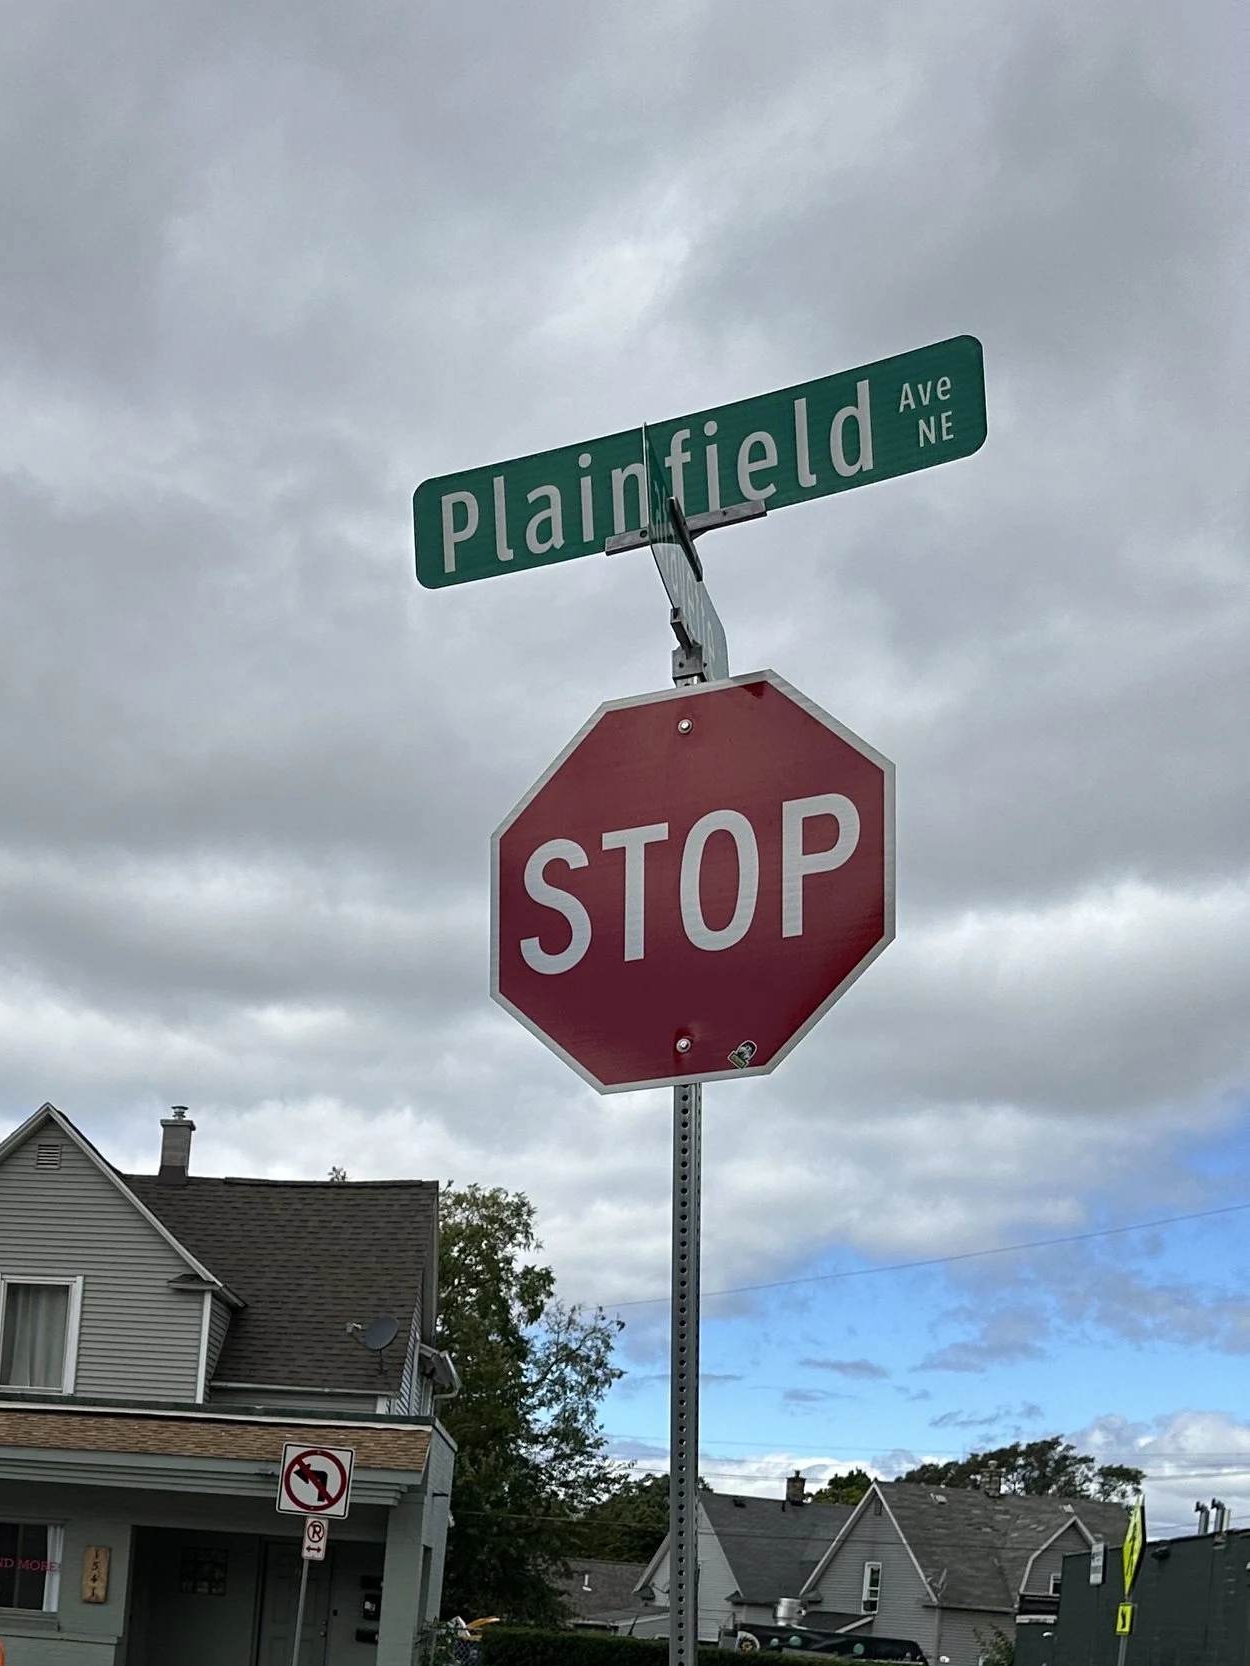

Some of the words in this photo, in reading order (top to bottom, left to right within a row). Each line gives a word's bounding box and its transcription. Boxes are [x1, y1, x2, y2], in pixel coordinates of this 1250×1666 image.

[441, 380, 874, 573] Plainfield
[897, 375, 952, 413] Ave
[918, 411, 955, 448] NE
[519, 792, 862, 976] STOP
